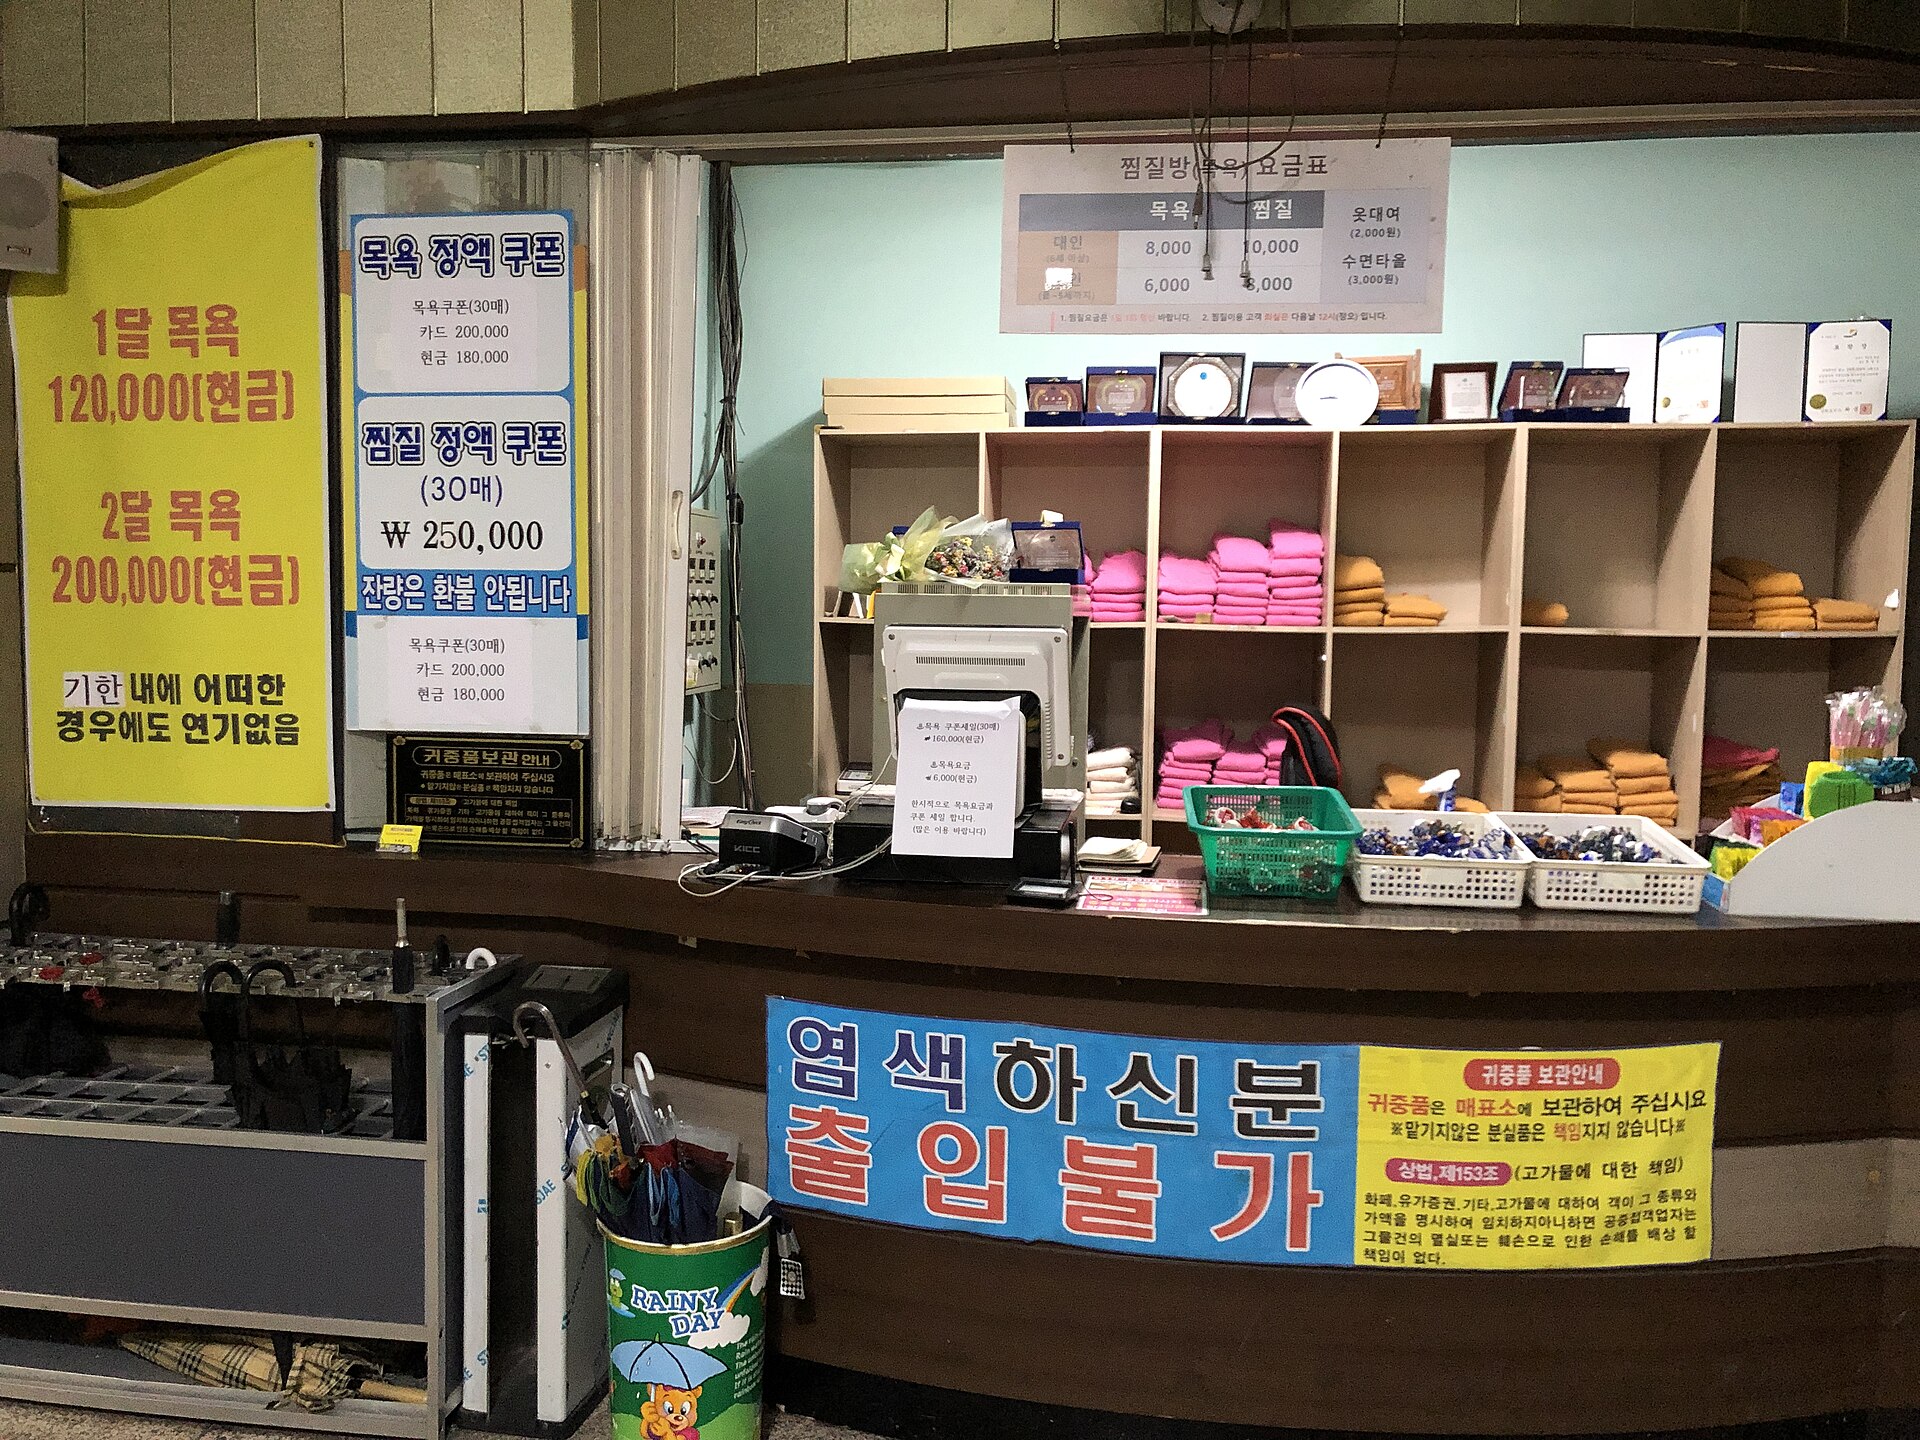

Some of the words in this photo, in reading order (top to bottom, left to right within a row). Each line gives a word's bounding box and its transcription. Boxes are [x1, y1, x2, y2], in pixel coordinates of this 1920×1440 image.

[1257, 154, 1328, 178] 요금표
[1150, 200, 1190, 221] 목욕
[1252, 199, 1293, 220] 찜질
[1352, 206, 1401, 223] 옷대여
[1053, 235, 1083, 250] 대인
[1145, 241, 1192, 257] 8,000
[359, 234, 423, 280] 목욕
[429, 233, 494, 279] 정액
[501, 232, 564, 277] 쿠폰
[1342, 253, 1408, 270] 수면타올
[1144, 278, 1190, 293] 6,000
[412, 298, 510, 316] 목욕쿠폰(30매)
[92, 308, 152, 360] 1달
[168, 304, 240, 358] 목욕
[419, 325, 449, 341] 카드
[420, 350, 449, 366] 현금
[48, 369, 295, 425] 120,000(현금)
[362, 422, 425, 466] 찜질
[431, 421, 497, 467] 정액
[502, 421, 567, 466] 쿠폰
[420, 475, 503, 507] (30매)
[101, 490, 152, 542] 2달
[170, 489, 241, 542] 목욕
[423, 520, 544, 556] 250,000
[52, 555, 300, 607] 200,000(현금)
[361, 573, 426, 612] 잔량은
[432, 573, 476, 612] 환불
[483, 574, 572, 613] 안됩니다
[408, 638, 506, 654] 목욕쿠폰(30매)
[416, 662, 445, 678] 카드
[64, 674, 123, 706] 기한
[130, 673, 181, 705] 내에
[193, 673, 286, 706] 어떠한
[417, 687, 445, 702] 현금
[56, 711, 172, 743] 경우에도
[182, 712, 299, 746] 연기없음
[486, 771, 519, 782] 보관하여
[911, 799, 951, 809] 한시적으로
[1482, 1064, 1533, 1086] 귀중품
[1537, 1063, 1604, 1086] 보관안내
[1367, 1093, 1447, 1117] 귀중품은
[1455, 1097, 1532, 1118] 매표소에
[1541, 1096, 1622, 1118] 보관하여
[1631, 1090, 1708, 1113] 주십시요
[1487, 1122, 1545, 1143] 분실품은
[1554, 1121, 1610, 1142] 책임지지
[1514, 1161, 1592, 1181] (고가물에
[1602, 1161, 1638, 1179] 대한
[1648, 1156, 1684, 1176] 책임)
[1557, 1196, 1600, 1211] 대하여
[1608, 1196, 1635, 1210] 객이
[1638, 1193, 1651, 1206] 그
[1657, 1187, 1697, 1204] 종류와
[1363, 1211, 1407, 1227] 가액을
[1415, 1213, 1474, 1230] 명시하여
[1564, 1234, 1593, 1249] 인한
[1363, 1247, 1406, 1264] 책임이
[631, 1284, 720, 1314] RAINY
[669, 1308, 726, 1339] DAY
